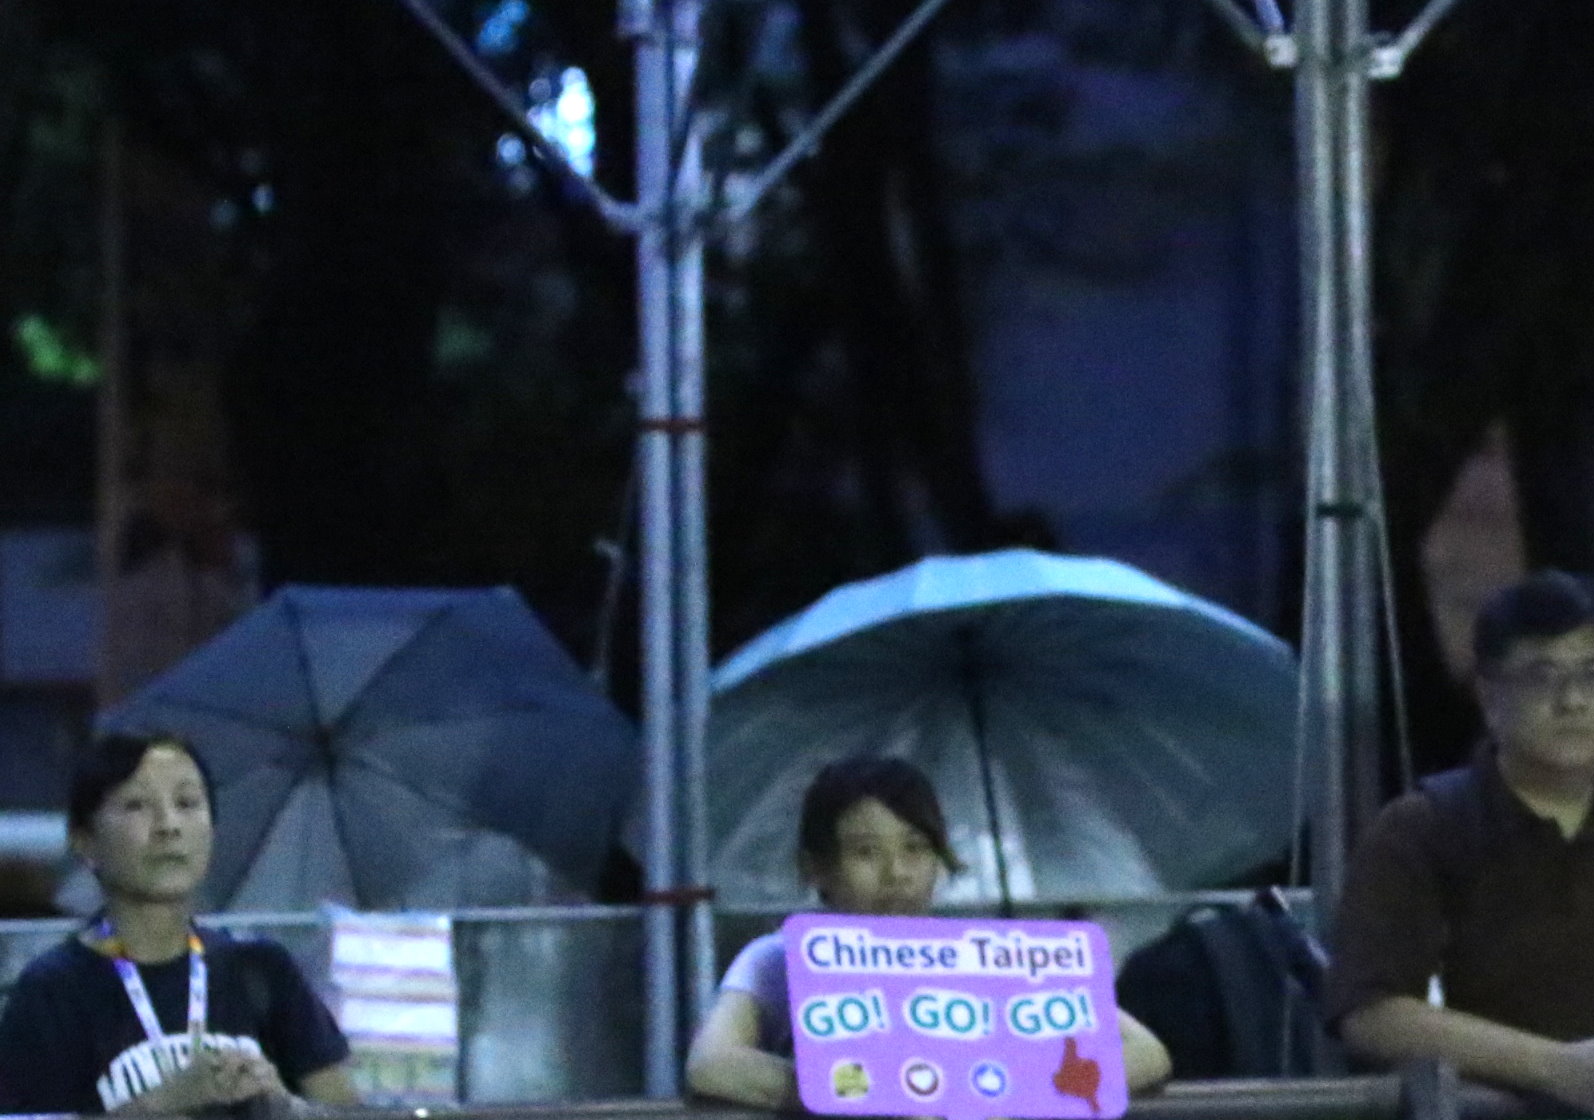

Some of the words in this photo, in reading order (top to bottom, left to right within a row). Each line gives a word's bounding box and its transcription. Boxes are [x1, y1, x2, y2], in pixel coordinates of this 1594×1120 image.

[806, 936, 957, 968] Chinese
[970, 937, 1086, 977] Taipei
[803, 995, 885, 1036] GO!
[909, 994, 990, 1036] GO!
[1010, 993, 1091, 1034] GO!
